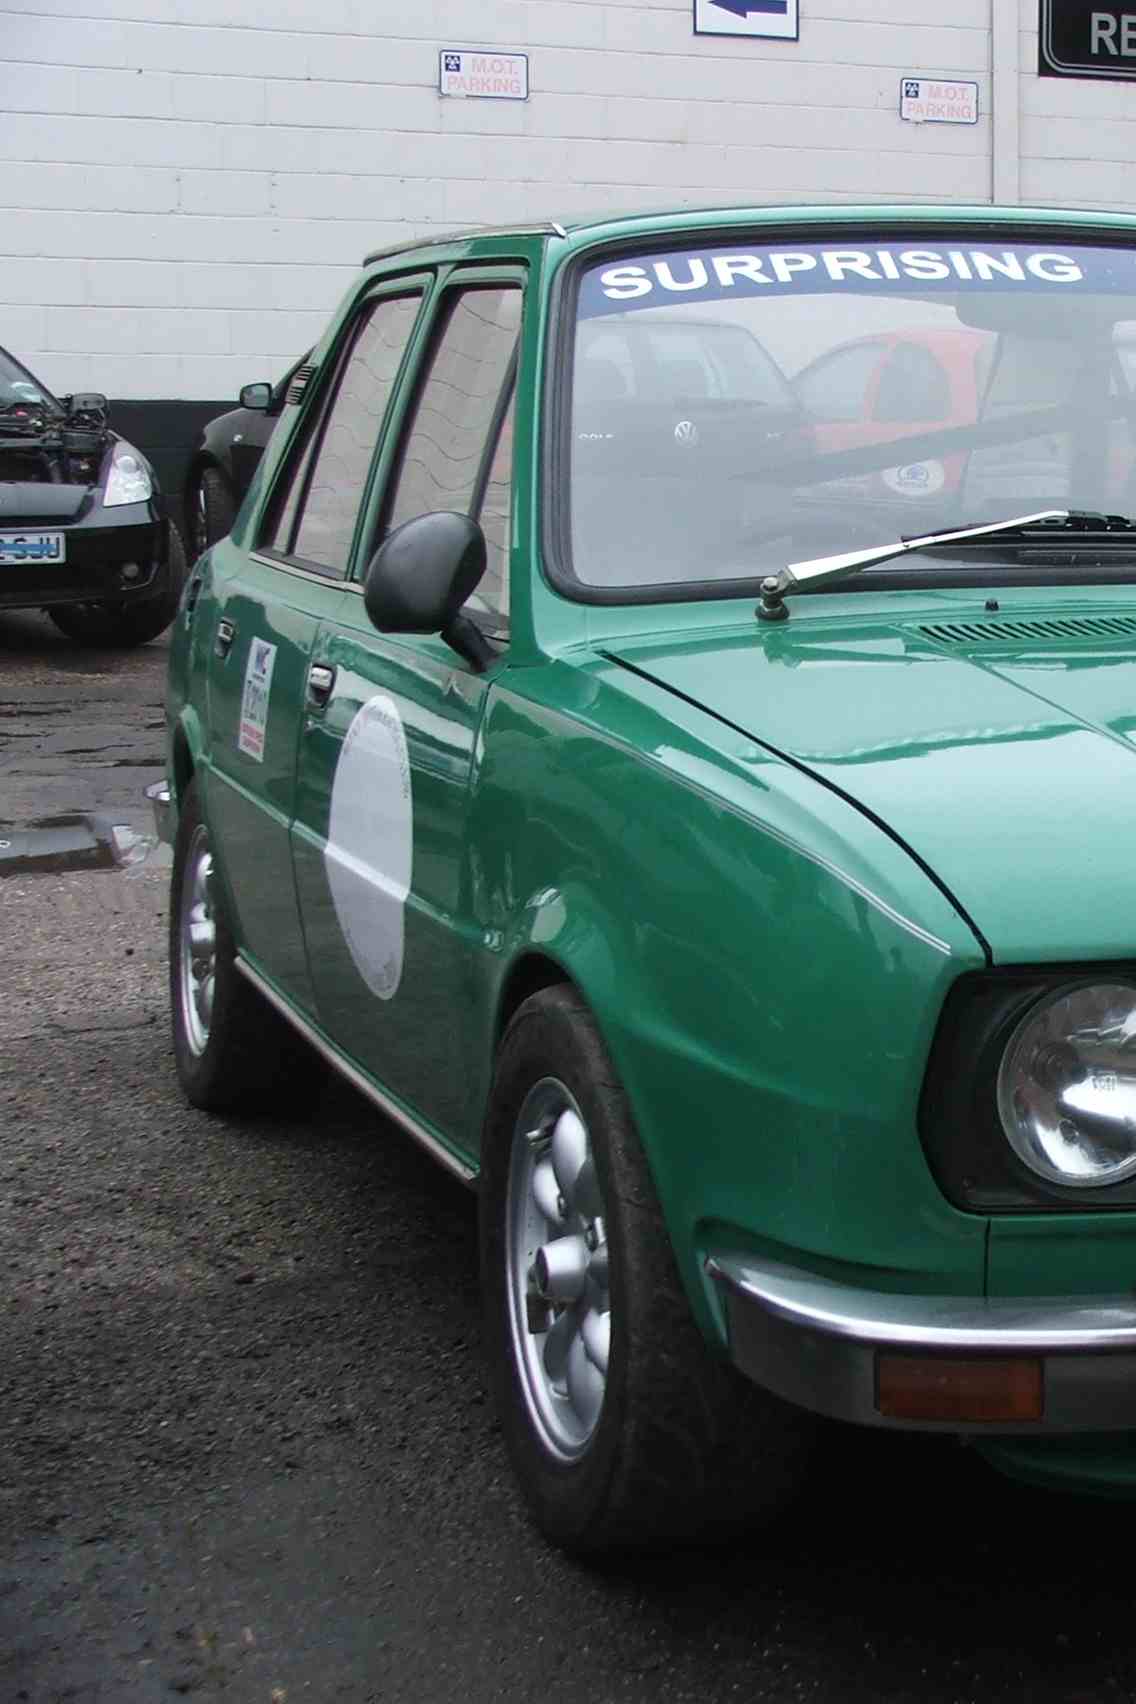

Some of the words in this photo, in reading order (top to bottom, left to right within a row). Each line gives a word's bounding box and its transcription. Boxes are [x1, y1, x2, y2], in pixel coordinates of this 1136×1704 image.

[446, 75, 521, 95] PARKING
[906, 101, 972, 119] PARKING
[600, 250, 1083, 299] SURPRISING
